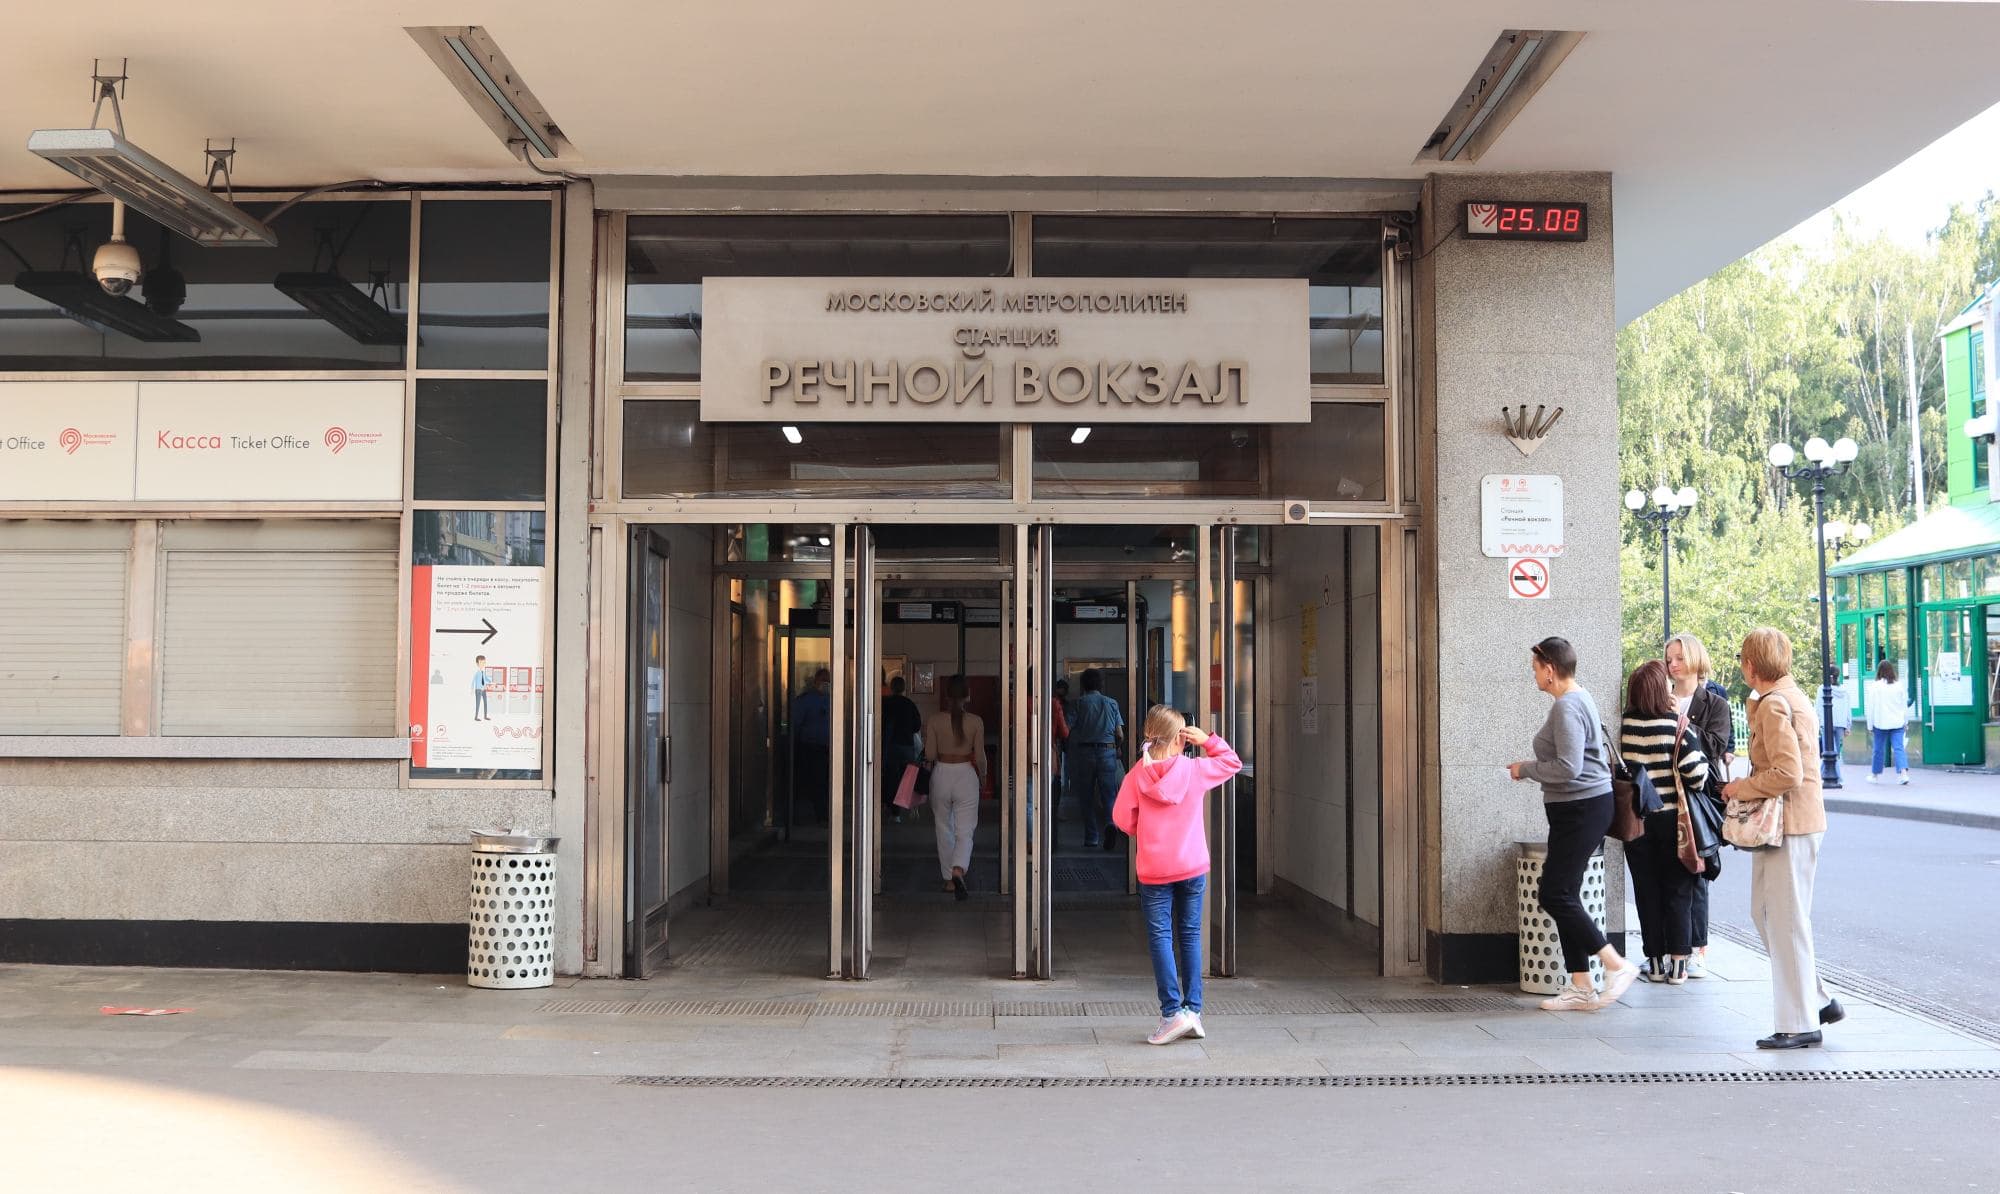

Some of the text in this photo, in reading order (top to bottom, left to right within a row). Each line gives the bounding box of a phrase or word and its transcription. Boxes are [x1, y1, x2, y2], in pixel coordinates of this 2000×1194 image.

[1499, 208, 1580, 232] 25.08
[825, 290, 1188, 313] МОСКОВСКИЙ МЕТРОПОЛИТЕН
[953, 327, 1060, 348] СТАНЦИЯ
[761, 347, 1250, 405] РЕЧНОЙ ВОКЗАЛ
[6, 436, 46, 450] Office
[157, 430, 310, 449] Касса Ticket Office
